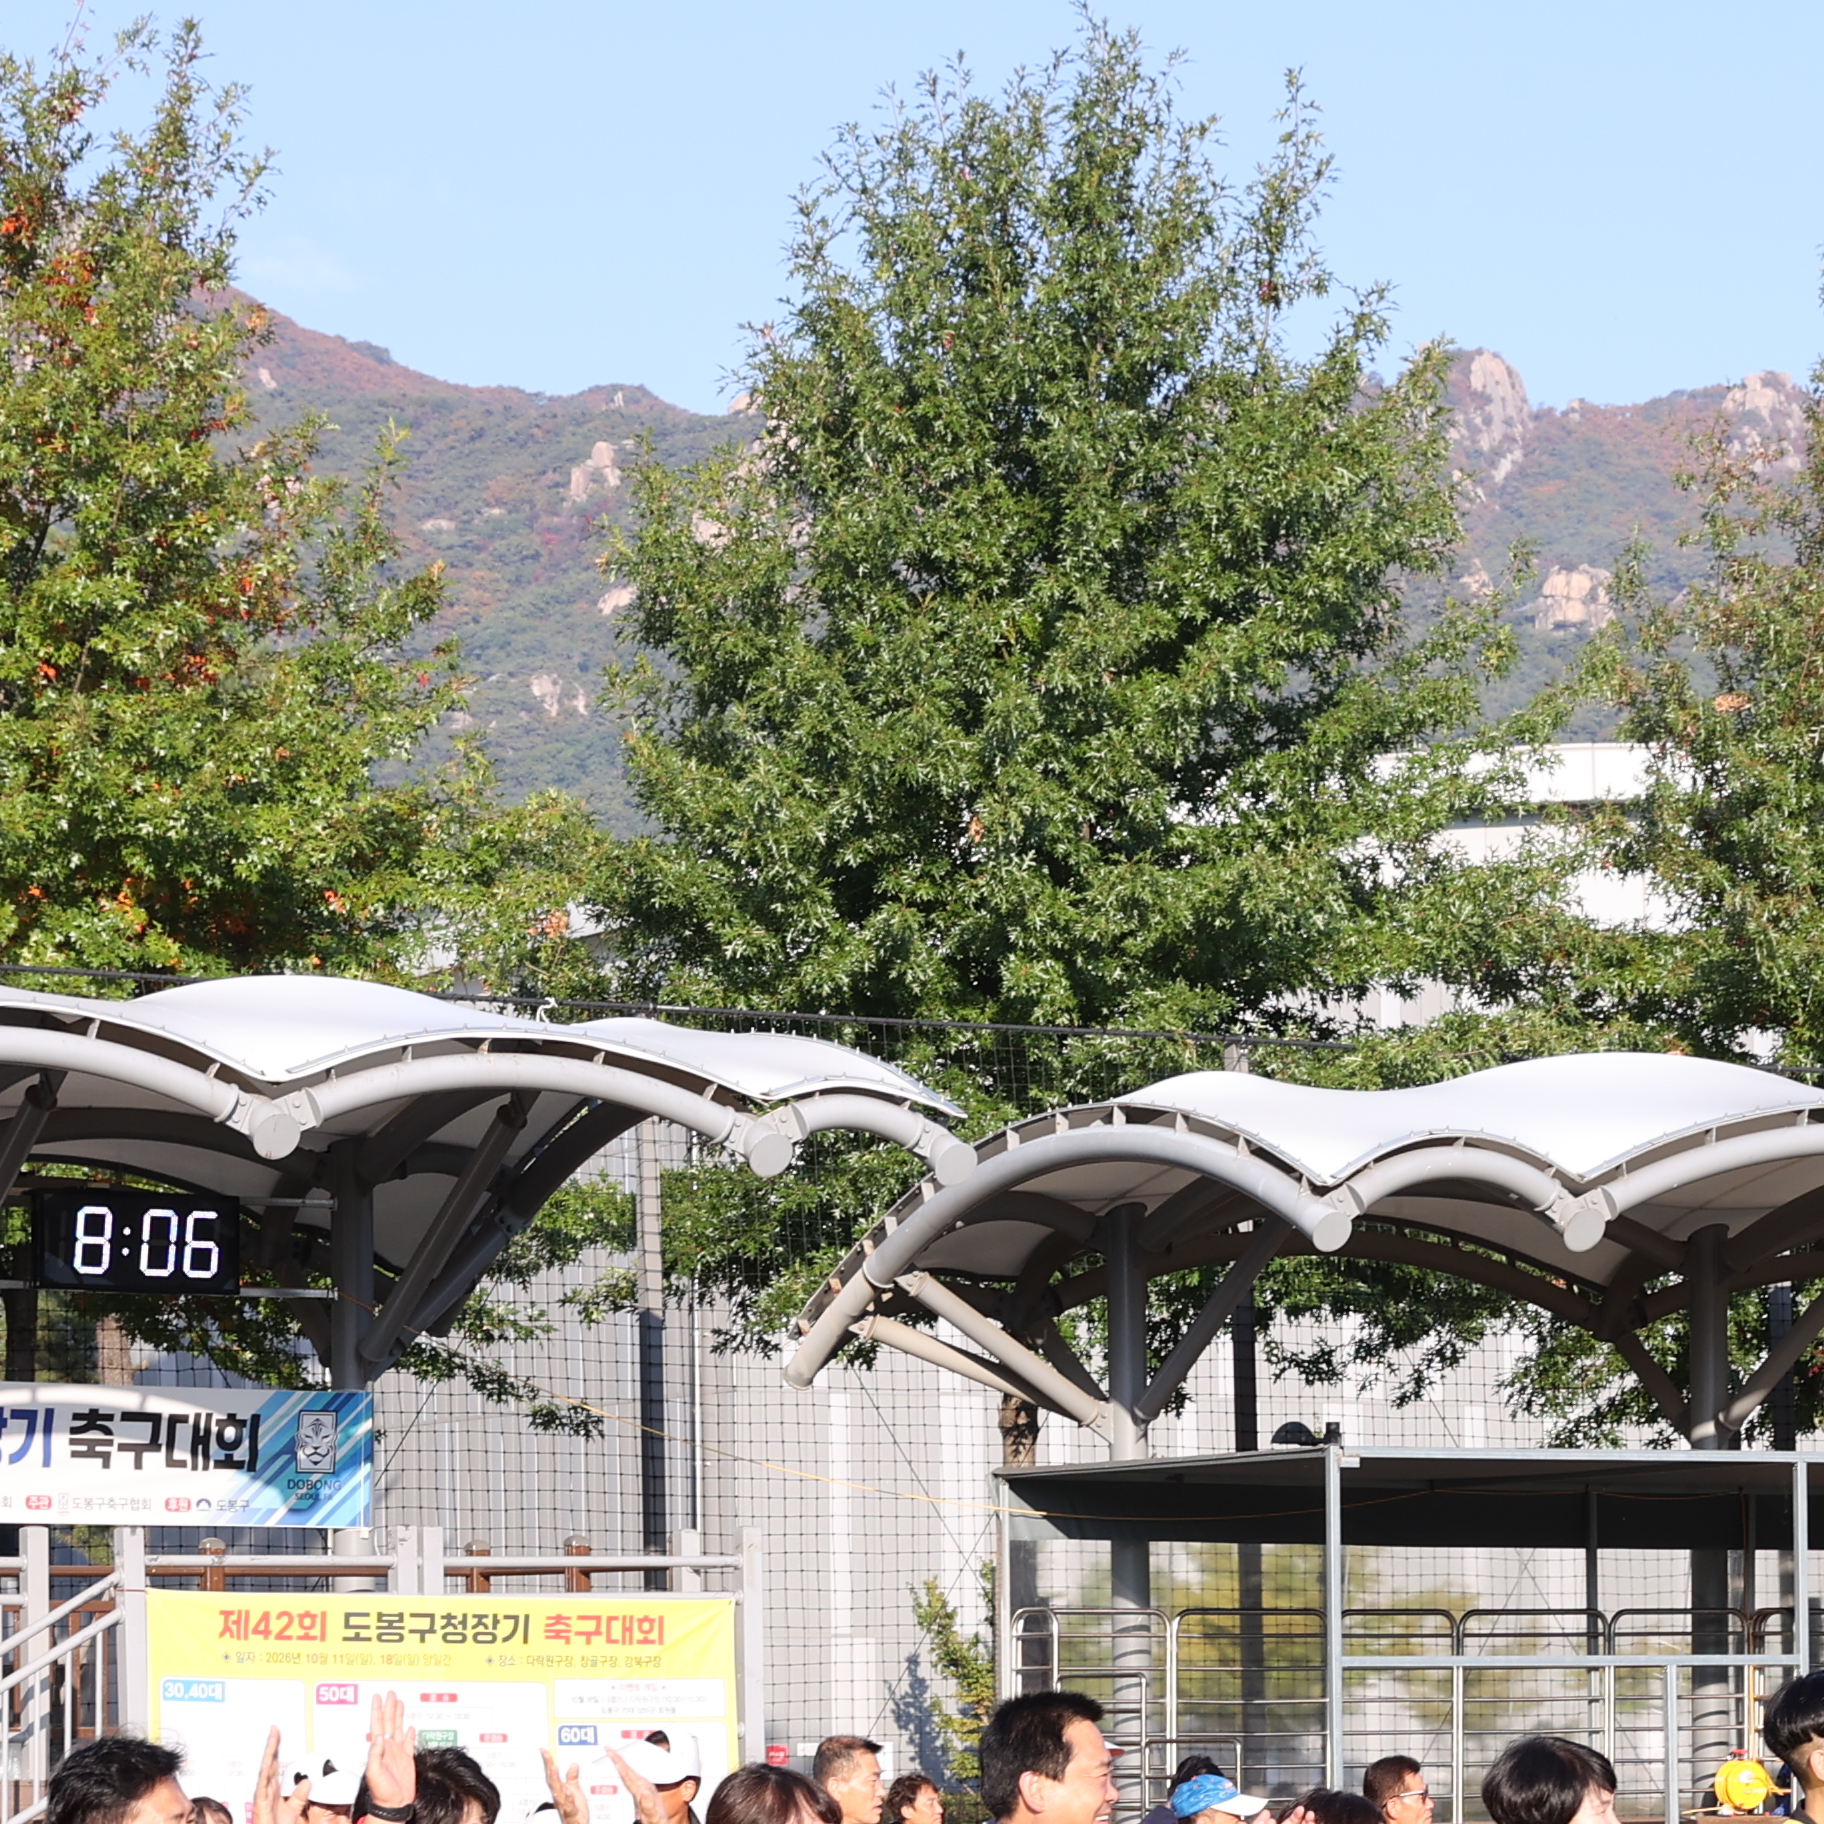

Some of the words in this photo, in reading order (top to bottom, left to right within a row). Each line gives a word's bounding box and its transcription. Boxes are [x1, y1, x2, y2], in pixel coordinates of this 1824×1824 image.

[73, 1205, 219, 1279] 8:06
[69, 1408, 261, 1473] 축구대회
[287, 1479, 342, 1491] DOBONG
[72, 1497, 152, 1512] 도봉구축구협회
[216, 1498, 250, 1513] 도봉구
[219, 1609, 327, 1642] 제42회
[342, 1611, 530, 1645] 도봉구청장기
[543, 1613, 665, 1646] 축구대회
[266, 1652, 301, 1664] 2026년
[305, 1653, 328, 1665] 10월
[423, 1653, 452, 1667] 양일간
[624, 1655, 662, 1668] 강북구장
[164, 1682, 224, 1699] 30,40대
[319, 1685, 355, 1703] 50대
[560, 1727, 595, 1744] 60대
